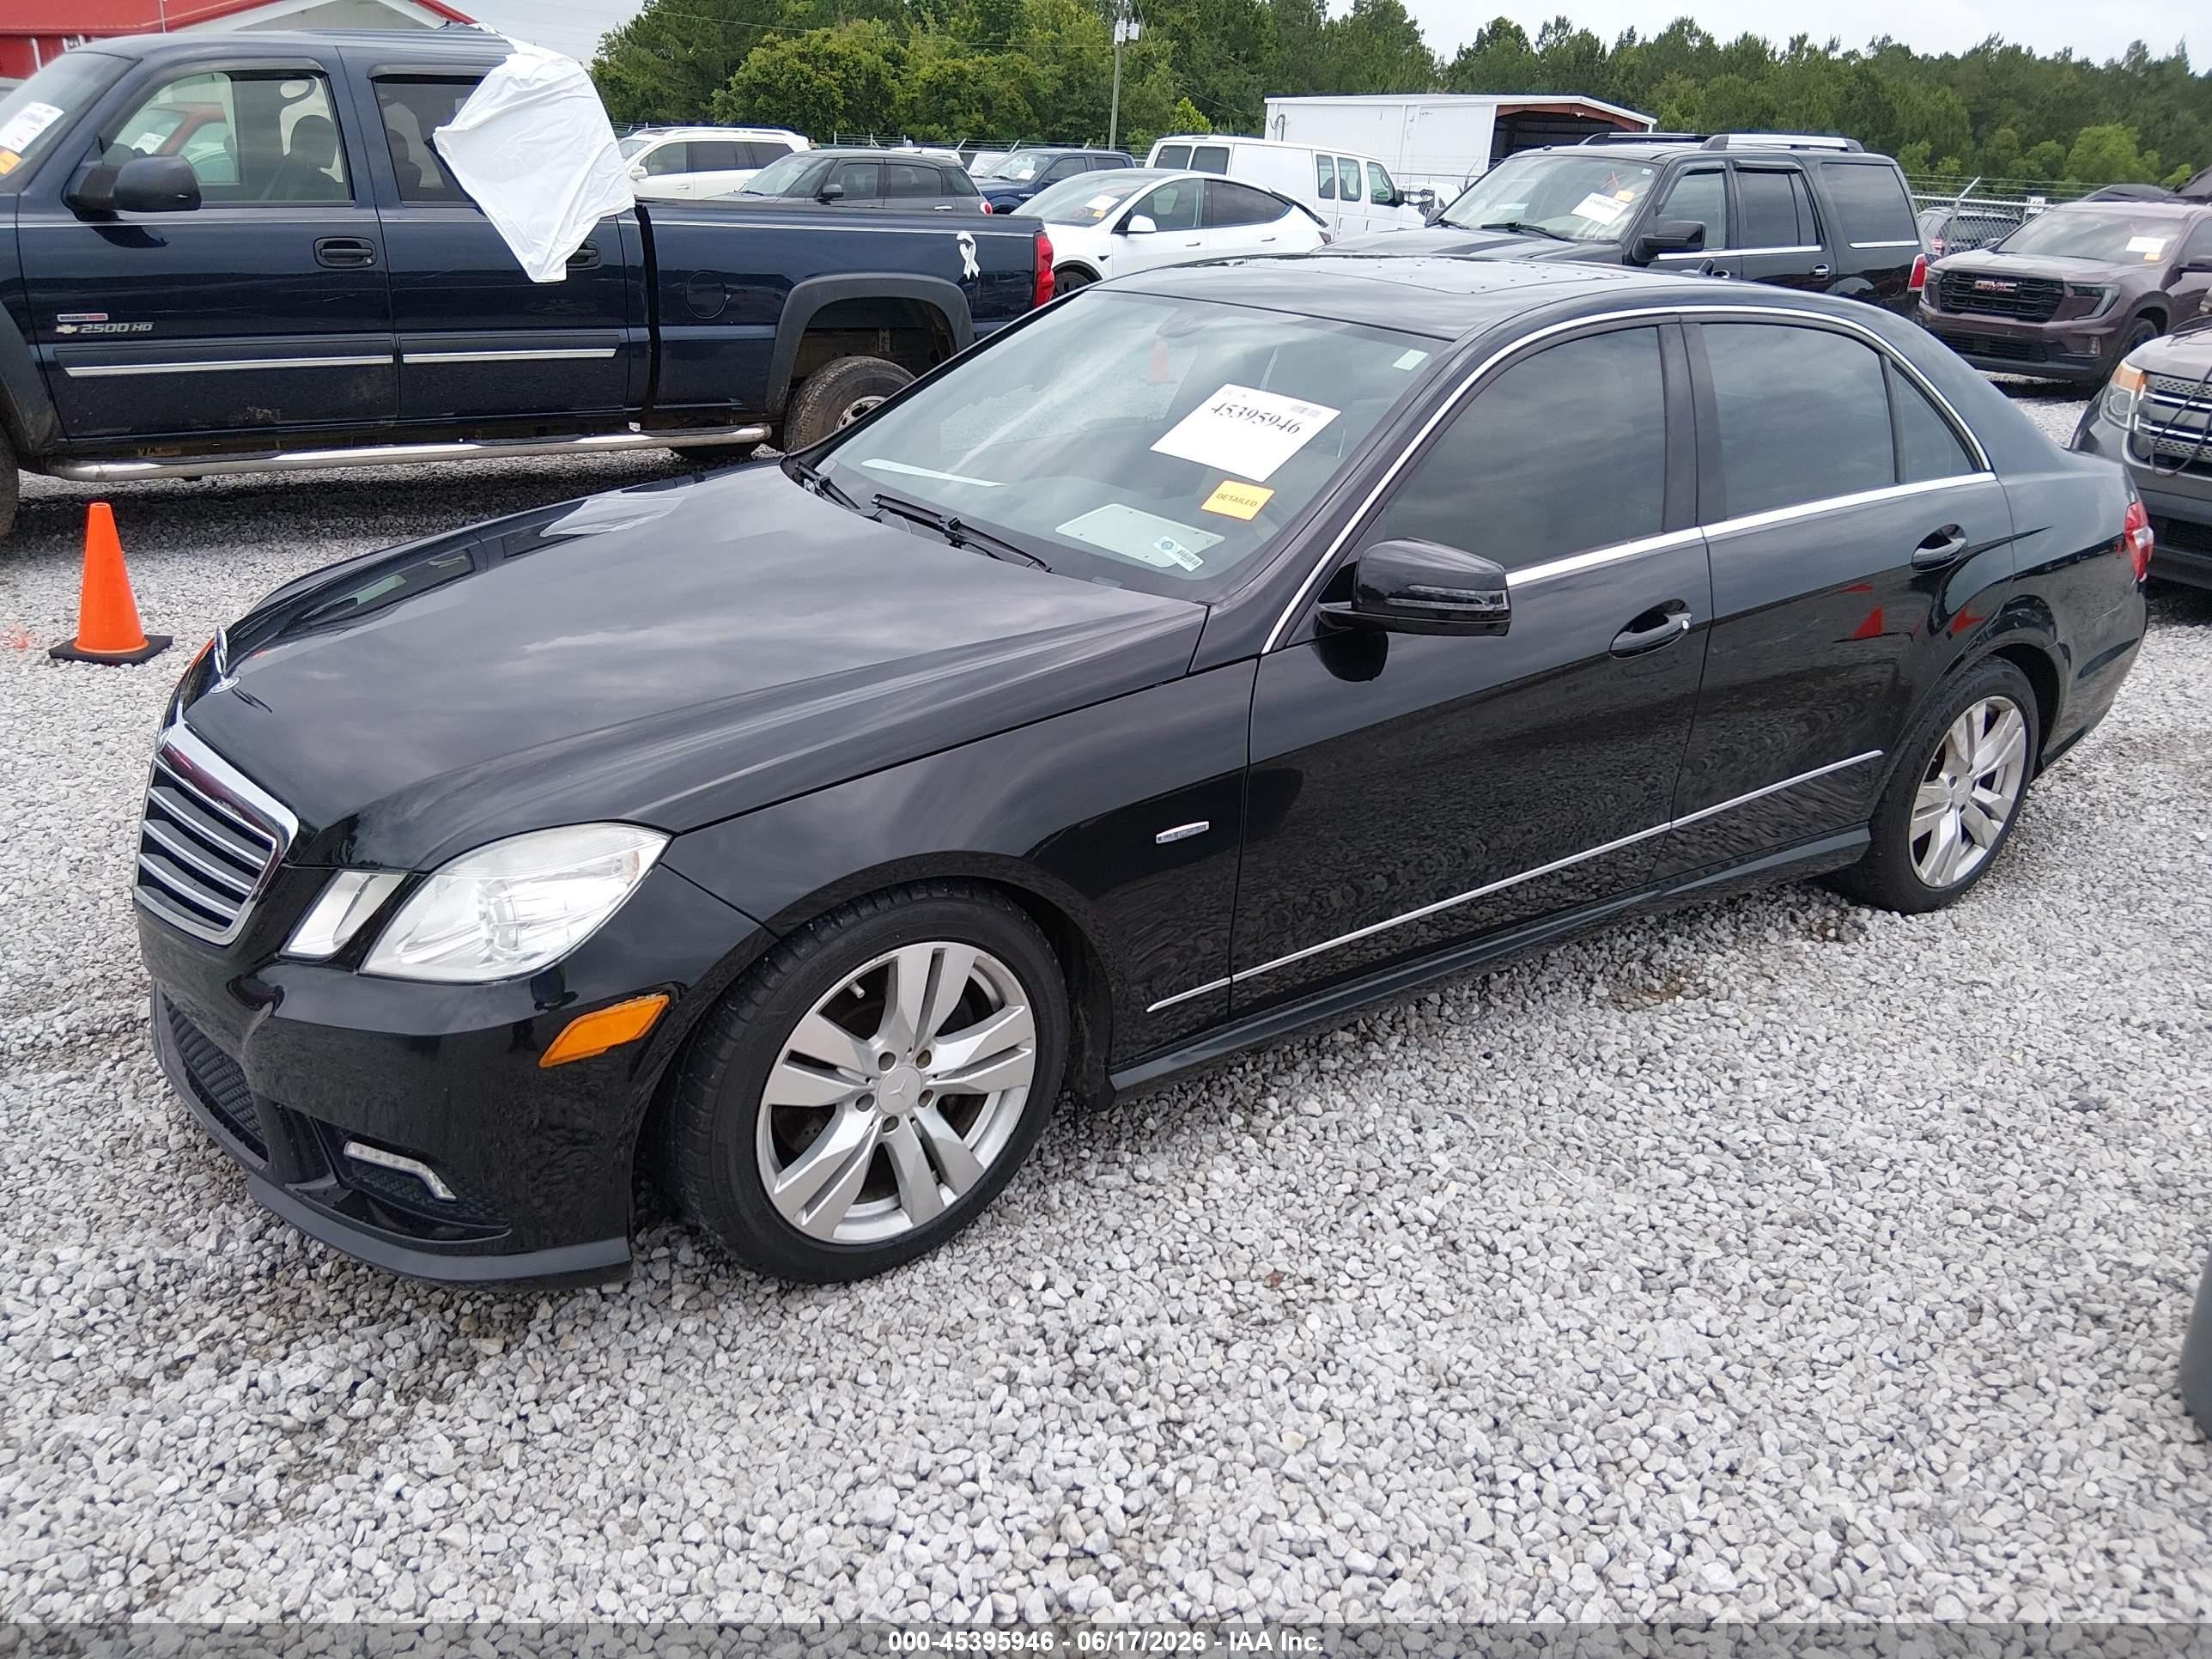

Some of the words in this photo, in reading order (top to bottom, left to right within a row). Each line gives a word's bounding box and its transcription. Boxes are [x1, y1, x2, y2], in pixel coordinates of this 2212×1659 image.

[1974, 280, 2018, 292] GMC
[81, 323, 130, 333] 2500
[1212, 403, 1304, 434] 45395946
[1216, 493, 1258, 507] DETAILED
